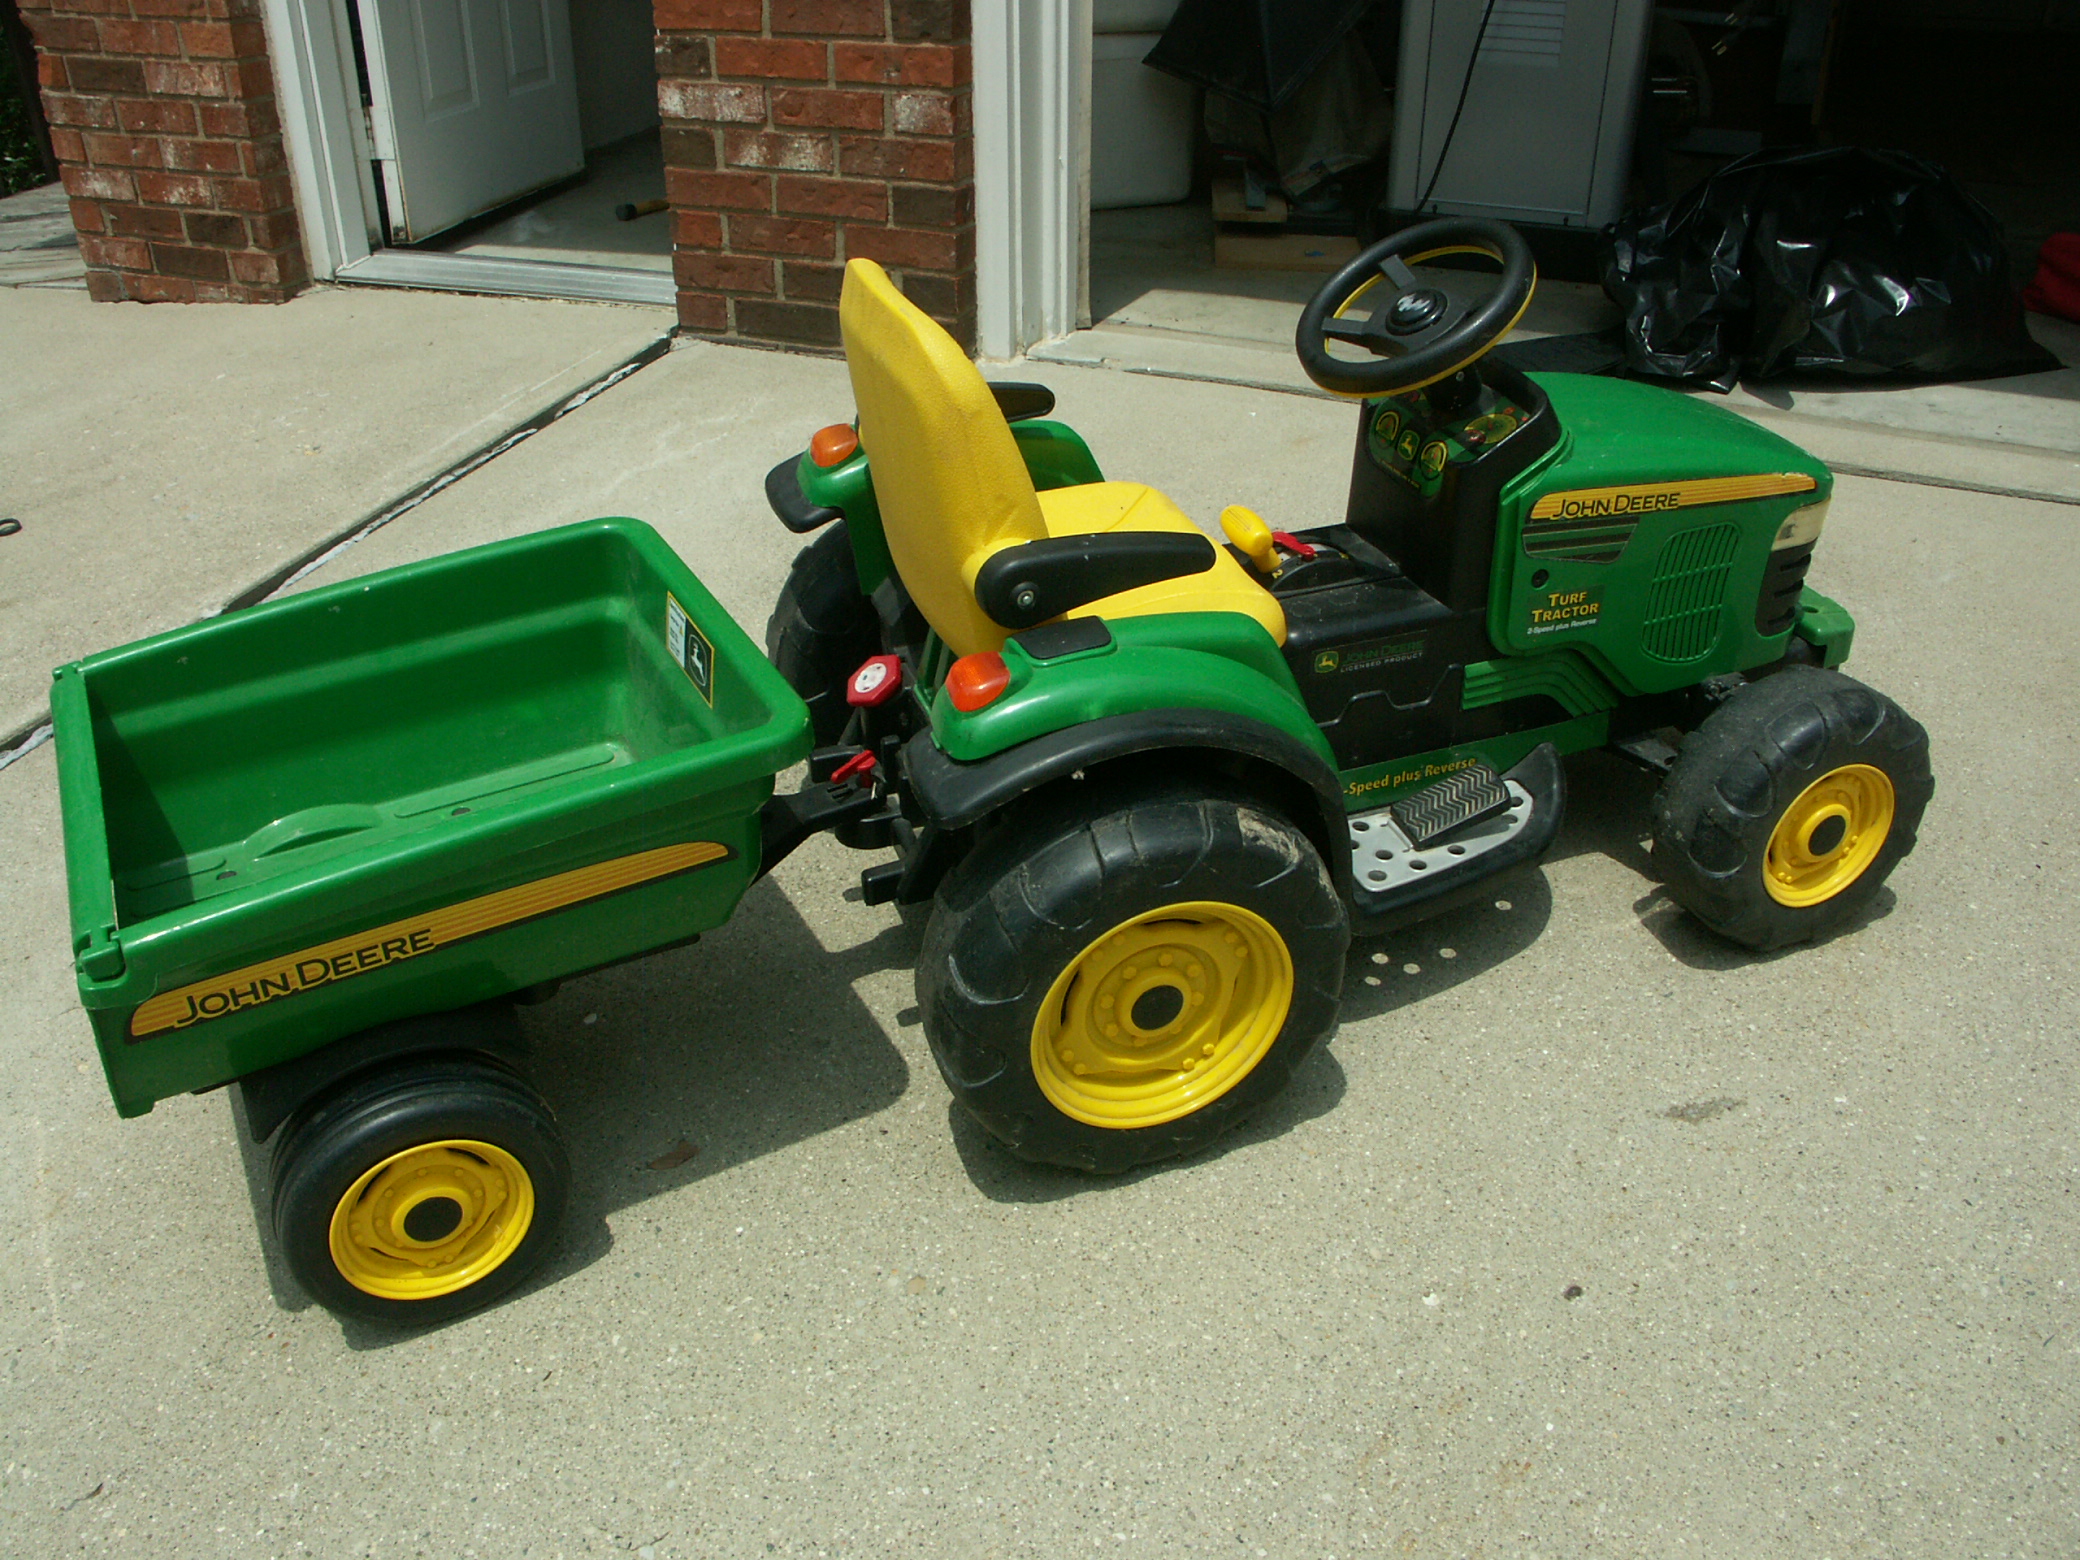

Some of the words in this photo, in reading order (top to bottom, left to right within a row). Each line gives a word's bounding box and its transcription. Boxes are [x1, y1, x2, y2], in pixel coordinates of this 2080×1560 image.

[1552, 498, 1611, 518] JOHN
[1613, 493, 1681, 513] DEERE
[1548, 592, 1588, 607] TURF
[1531, 603, 1600, 623] TRACTOR
[1340, 660, 1382, 673] LICENSED
[1383, 652, 1423, 664] PRODUCT
[1392, 771, 1421, 787] plus
[1424, 758, 1477, 777] Reverse
[176, 972, 291, 1024] JOHN
[295, 929, 435, 987] DEERE
